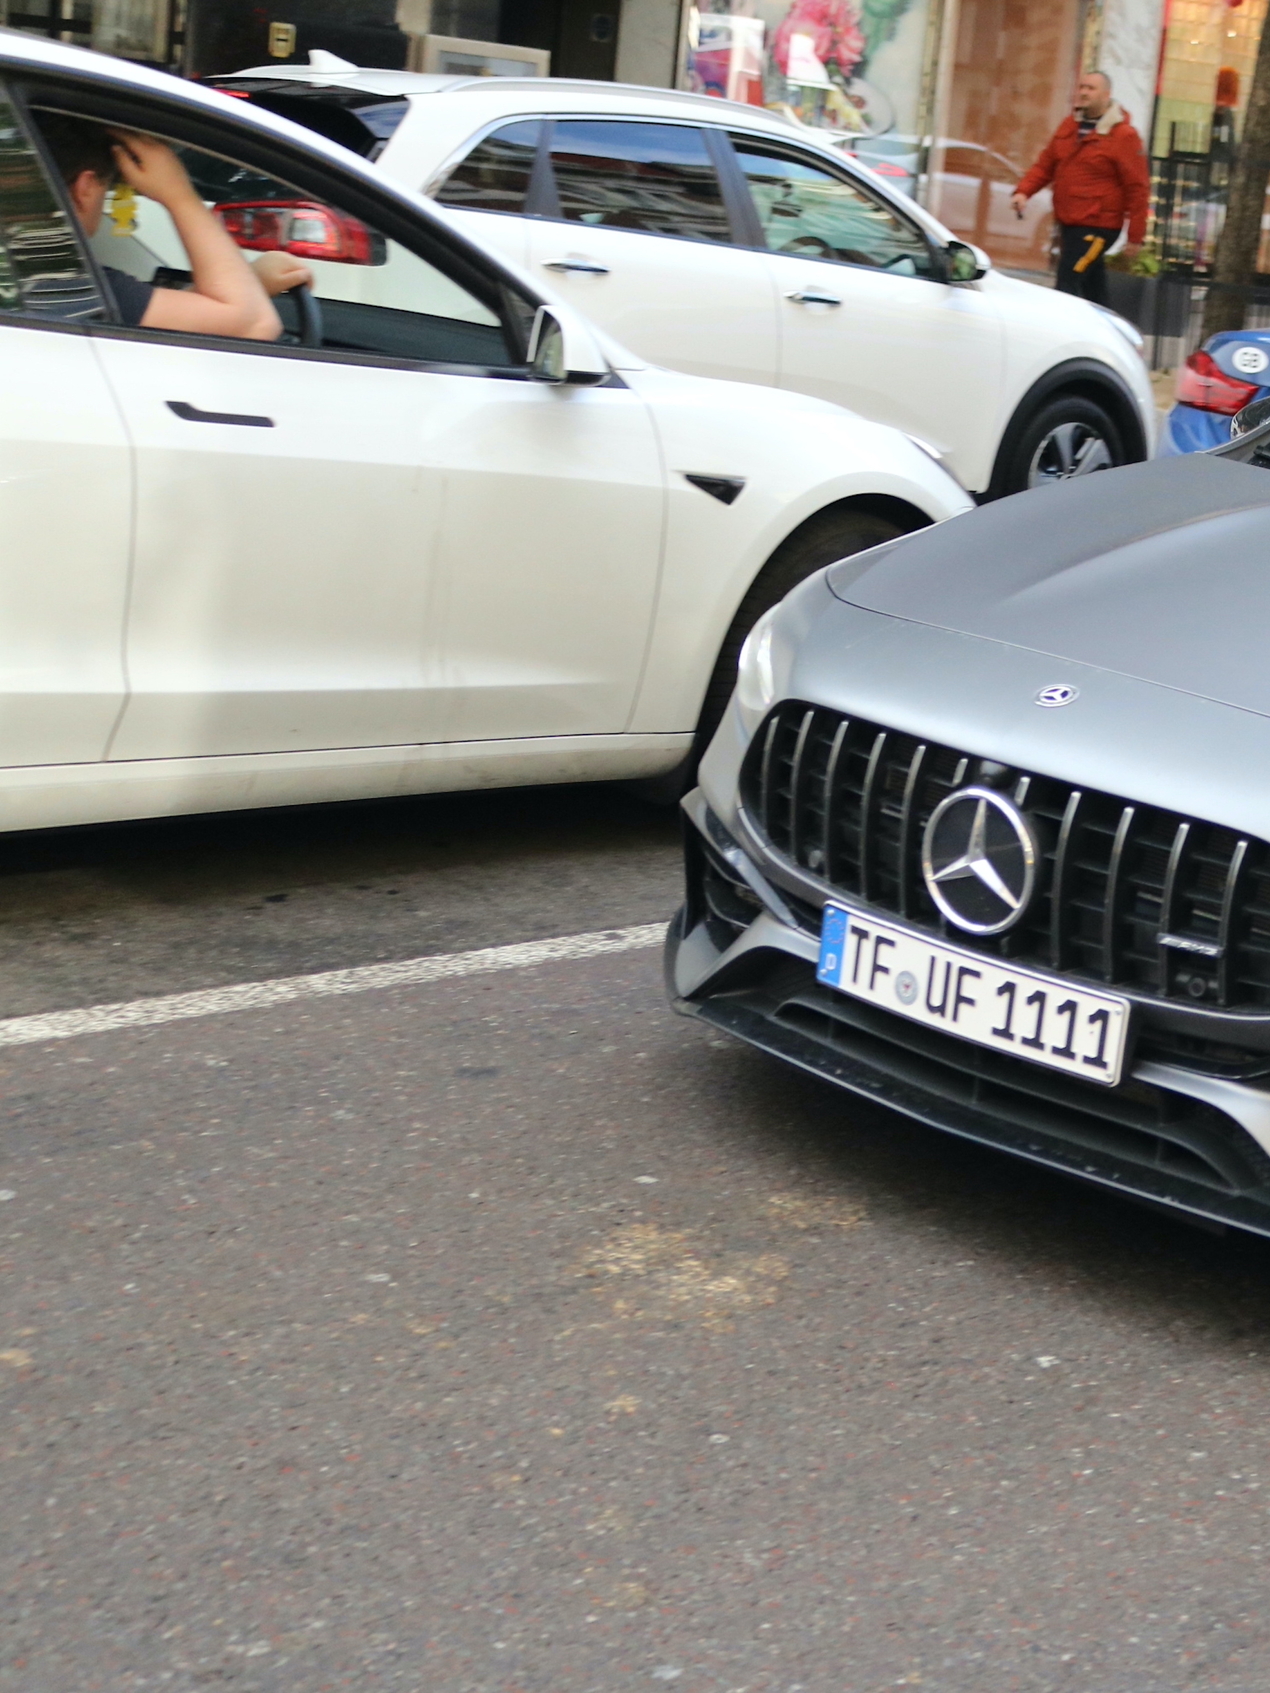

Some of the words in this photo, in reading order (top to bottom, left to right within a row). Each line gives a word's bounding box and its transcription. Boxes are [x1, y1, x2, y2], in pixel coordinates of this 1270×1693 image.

[1240, 351, 1259, 369] GB
[850, 924, 896, 991] TF
[925, 955, 982, 1023] UF
[991, 980, 1111, 1071] 1111
